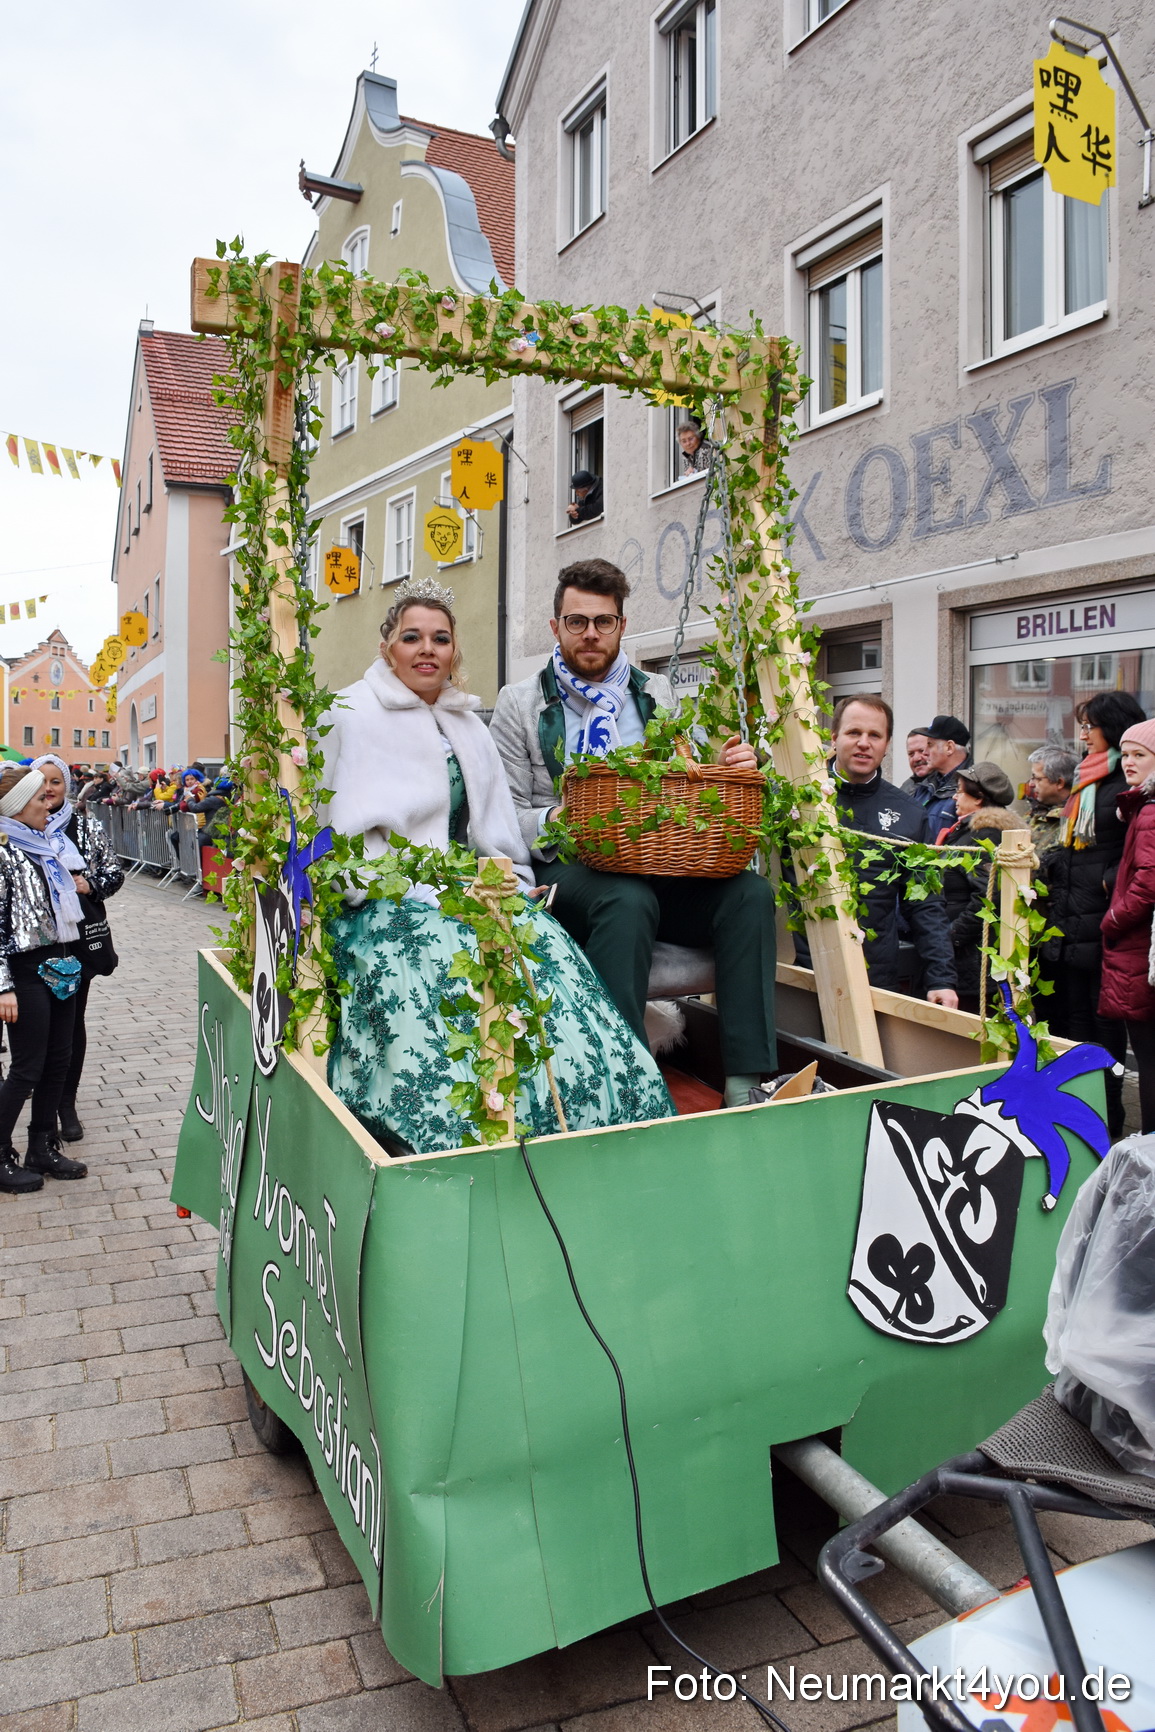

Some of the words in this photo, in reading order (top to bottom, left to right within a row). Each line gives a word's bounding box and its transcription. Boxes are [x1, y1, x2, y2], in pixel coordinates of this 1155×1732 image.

[656, 471, 827, 600] OPK
[843, 377, 1114, 553] OEXL
[1016, 603, 1116, 640] BRILLEN
